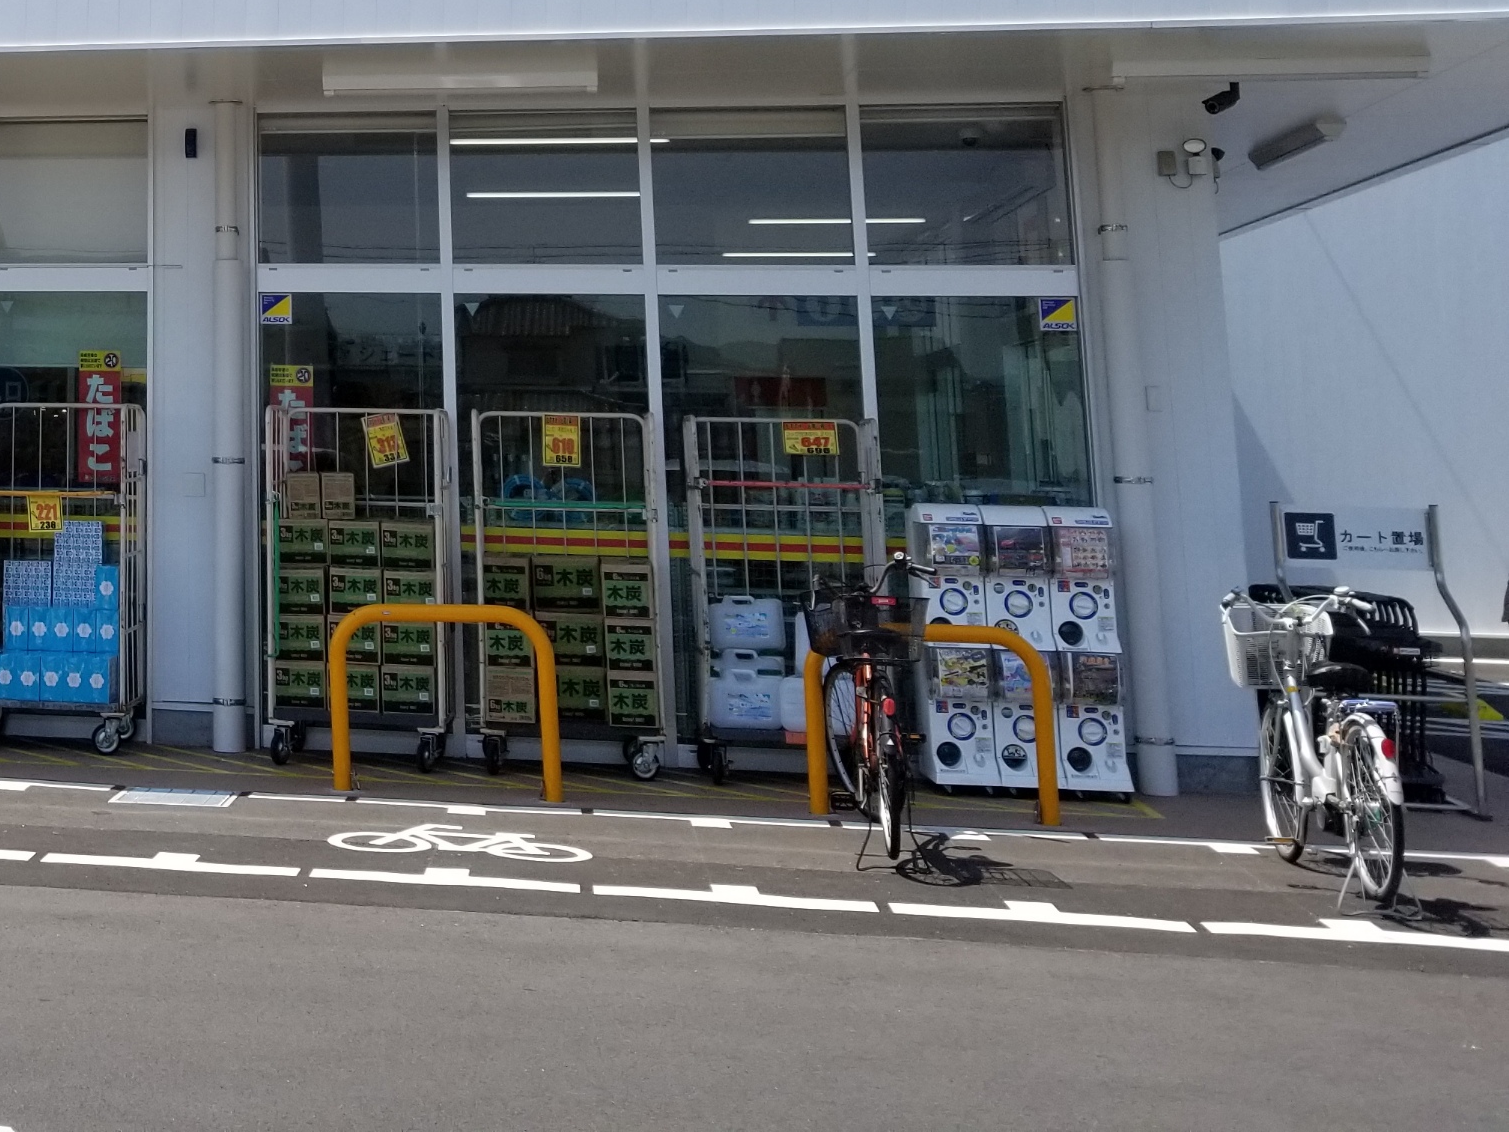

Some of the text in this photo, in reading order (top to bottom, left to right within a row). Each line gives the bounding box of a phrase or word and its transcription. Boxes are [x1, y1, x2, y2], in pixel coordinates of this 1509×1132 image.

[1042, 322, 1076, 330] ALSOK
[85, 374, 114, 471] たばこ
[35, 503, 58, 521] 221
[1340, 529, 1424, 546] カート置場
